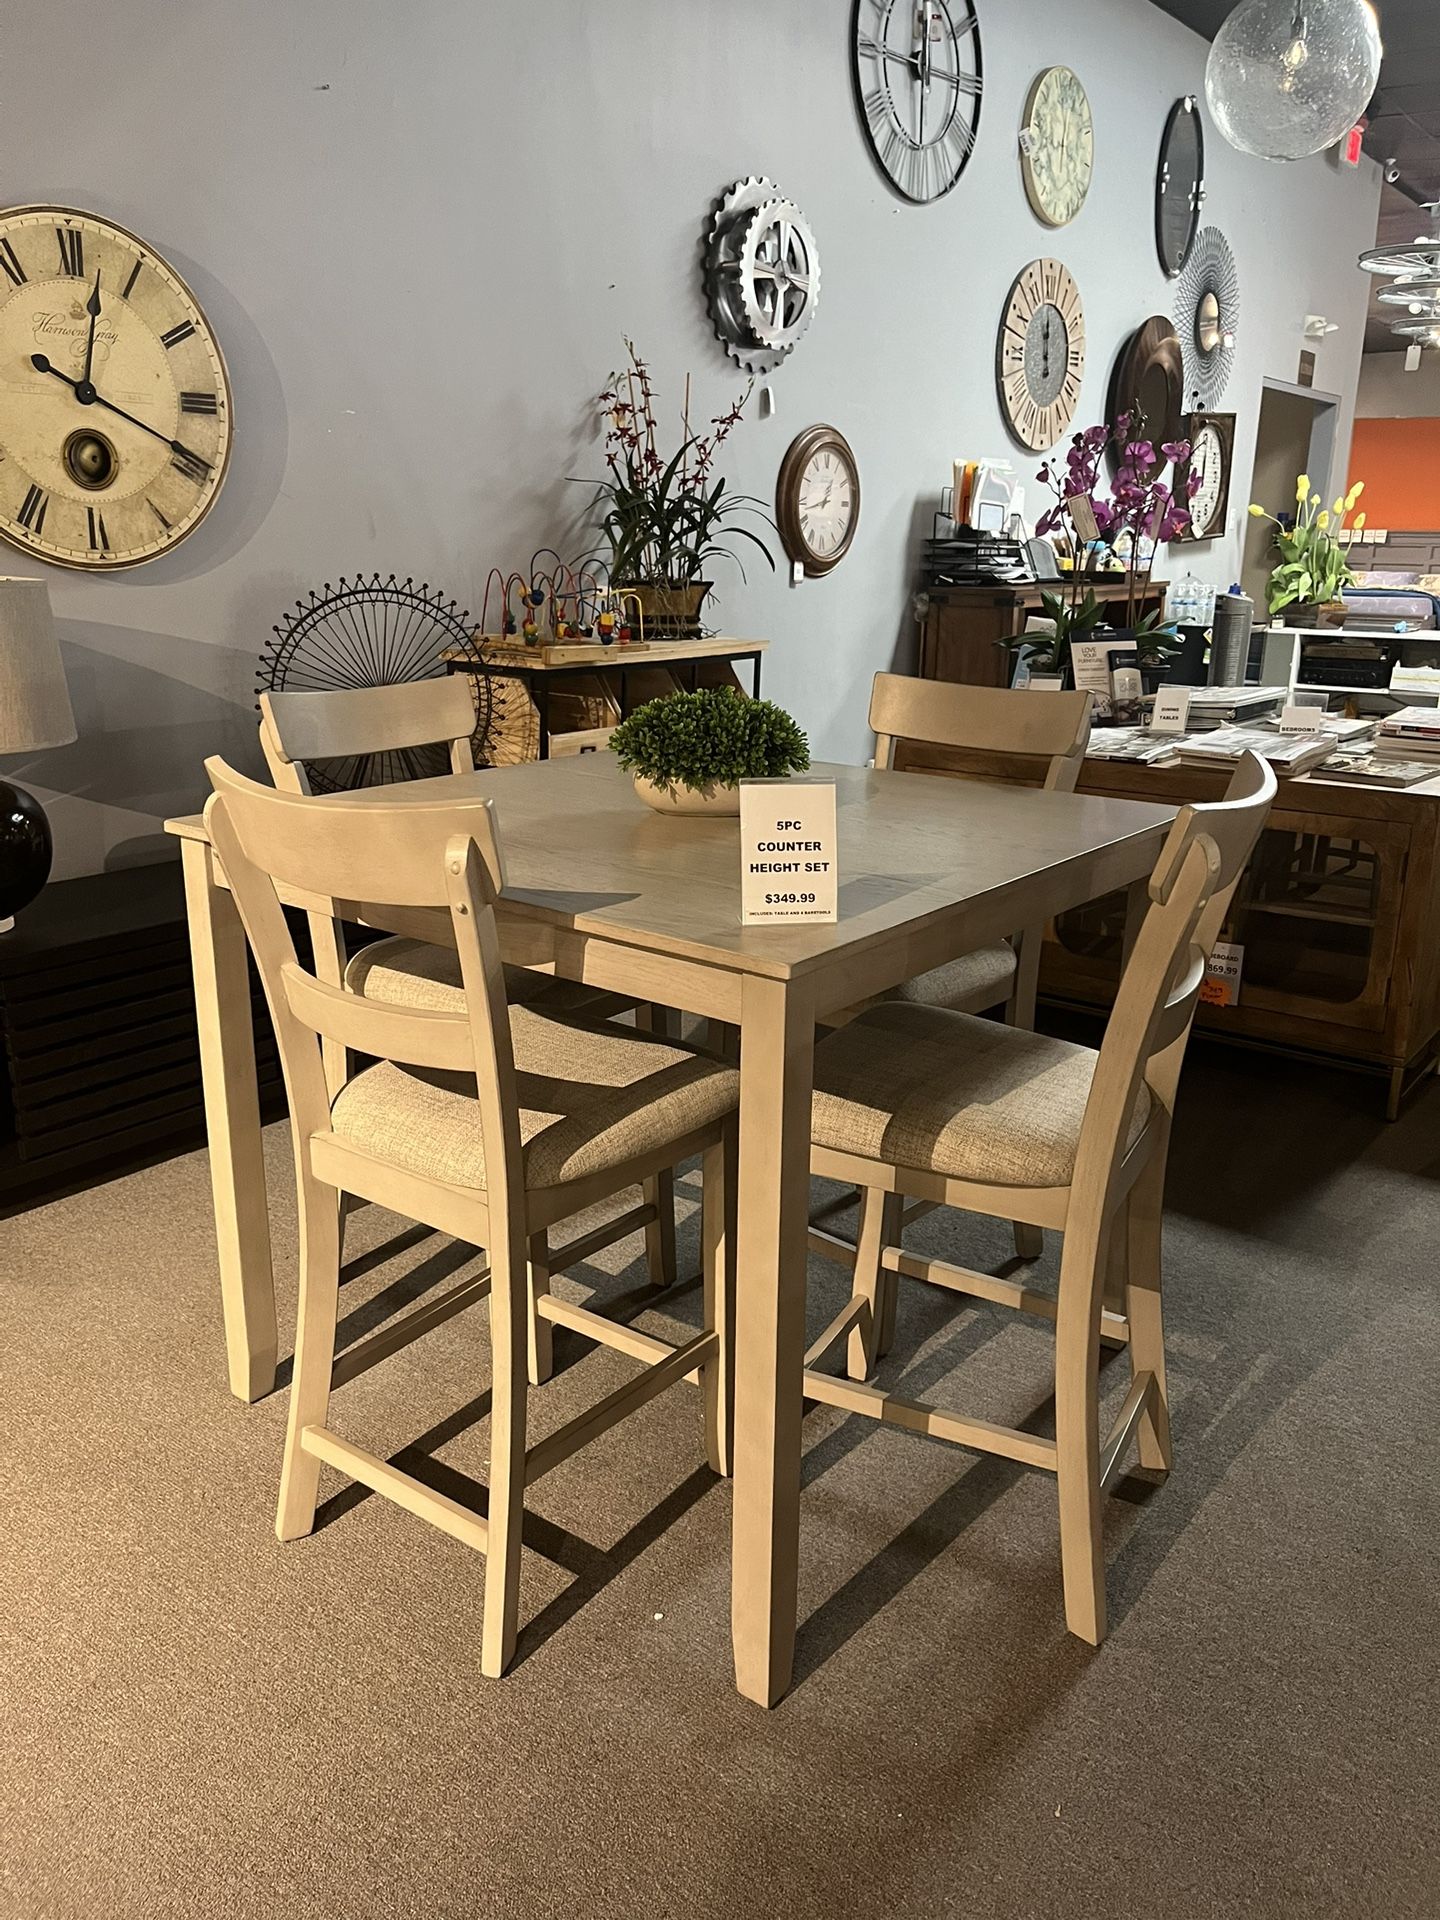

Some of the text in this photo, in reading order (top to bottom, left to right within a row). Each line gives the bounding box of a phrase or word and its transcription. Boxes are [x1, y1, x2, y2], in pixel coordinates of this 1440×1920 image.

[179, 391, 218, 415] III
[776, 821, 802, 830] 5PC
[757, 842, 822, 851] COUNTER
[750, 862, 830, 873] HEIGHT SET
[765, 893, 816, 904] $349.99
[1211, 953, 1239, 962] EBOARD
